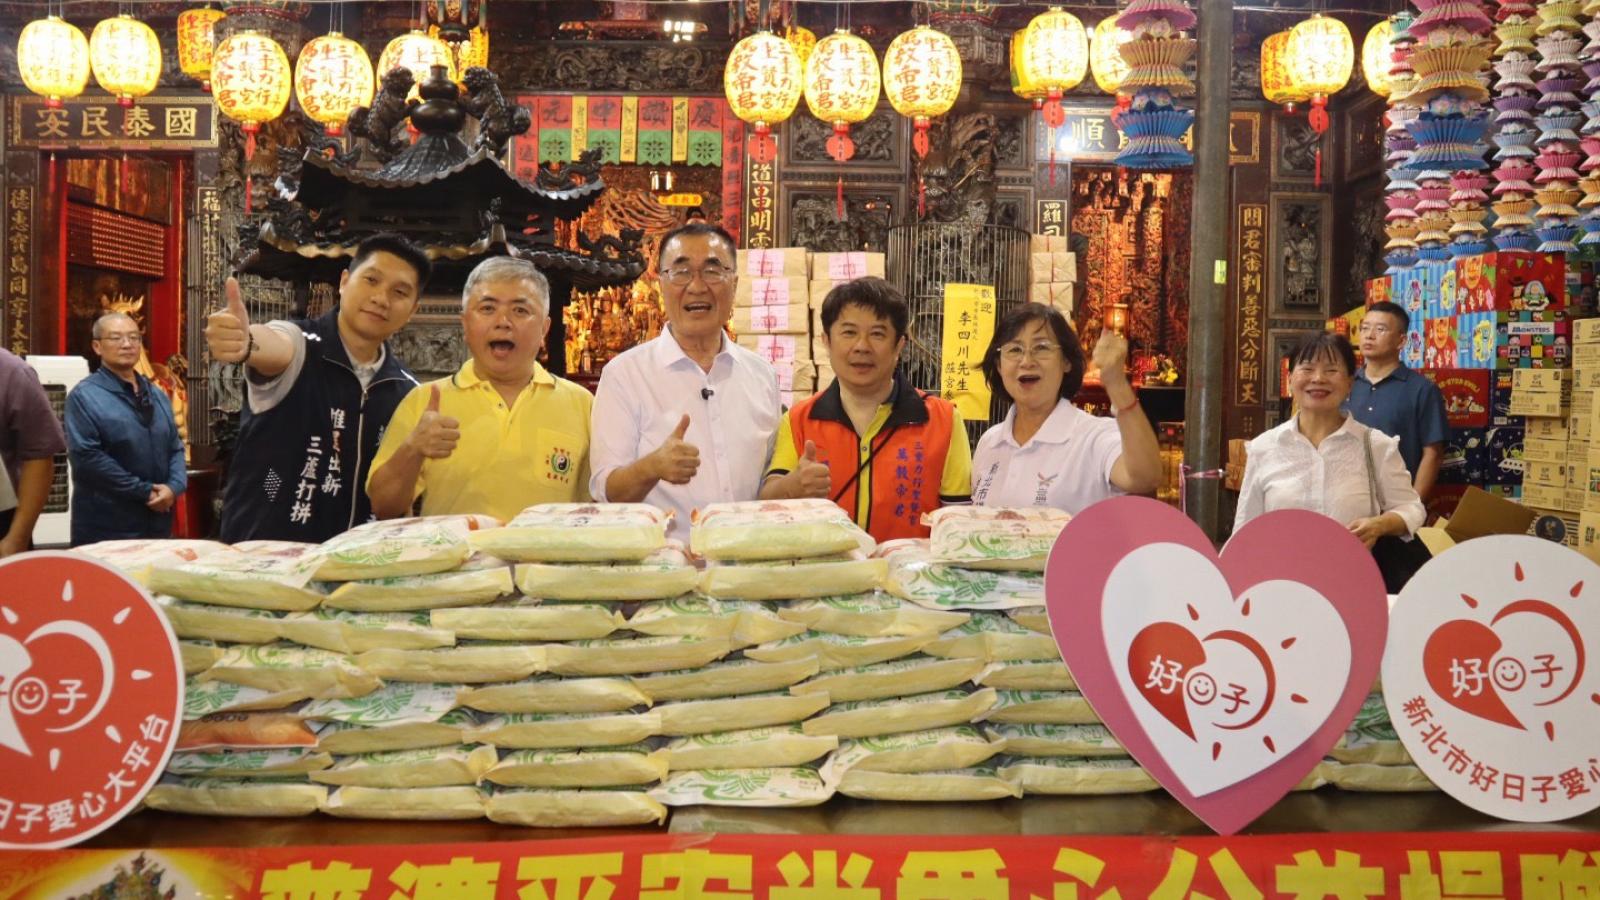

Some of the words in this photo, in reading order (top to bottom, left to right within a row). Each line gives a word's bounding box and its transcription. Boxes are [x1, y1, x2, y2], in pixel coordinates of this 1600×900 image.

[35, 106, 198, 138] 國泰民安
[980, 287, 993, 314] 歡迎
[956, 310, 972, 391] 李四川先生
[290, 435, 323, 525] 三蘆打拼
